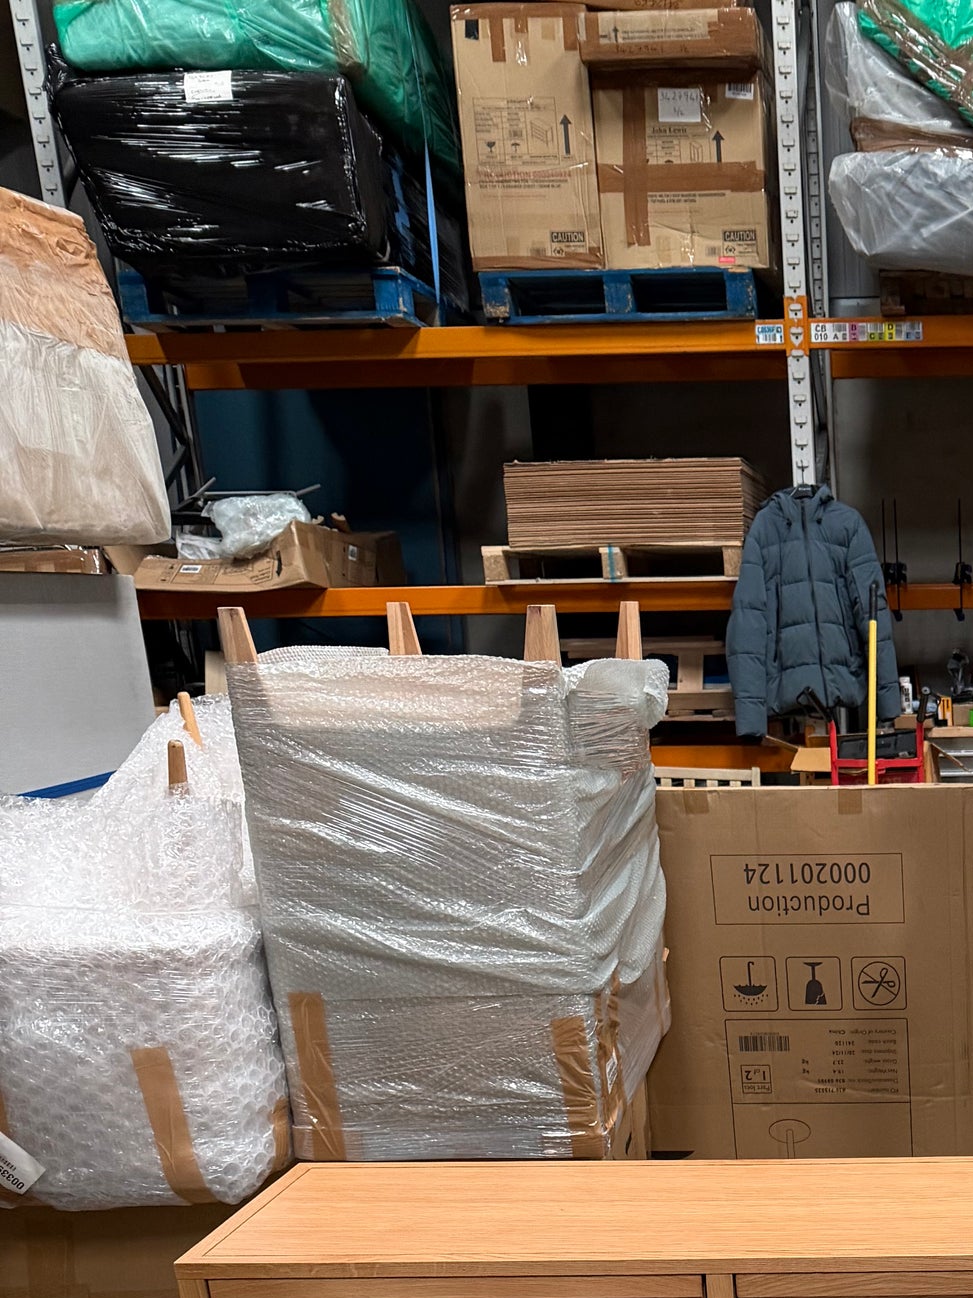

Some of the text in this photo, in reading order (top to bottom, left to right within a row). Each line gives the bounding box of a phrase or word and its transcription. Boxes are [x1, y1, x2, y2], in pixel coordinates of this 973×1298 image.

[552, 232, 584, 242] CAUTION
[724, 230, 756, 241] CAUTION
[814, 324, 827, 332] CB
[888, 323, 894, 331] D
[814, 333, 828, 341] 010
[743, 862, 871, 884] 000201124
[748, 895, 870, 916] Production
[744, 1070, 752, 1080] 2
[762, 1070, 766, 1080] 1
